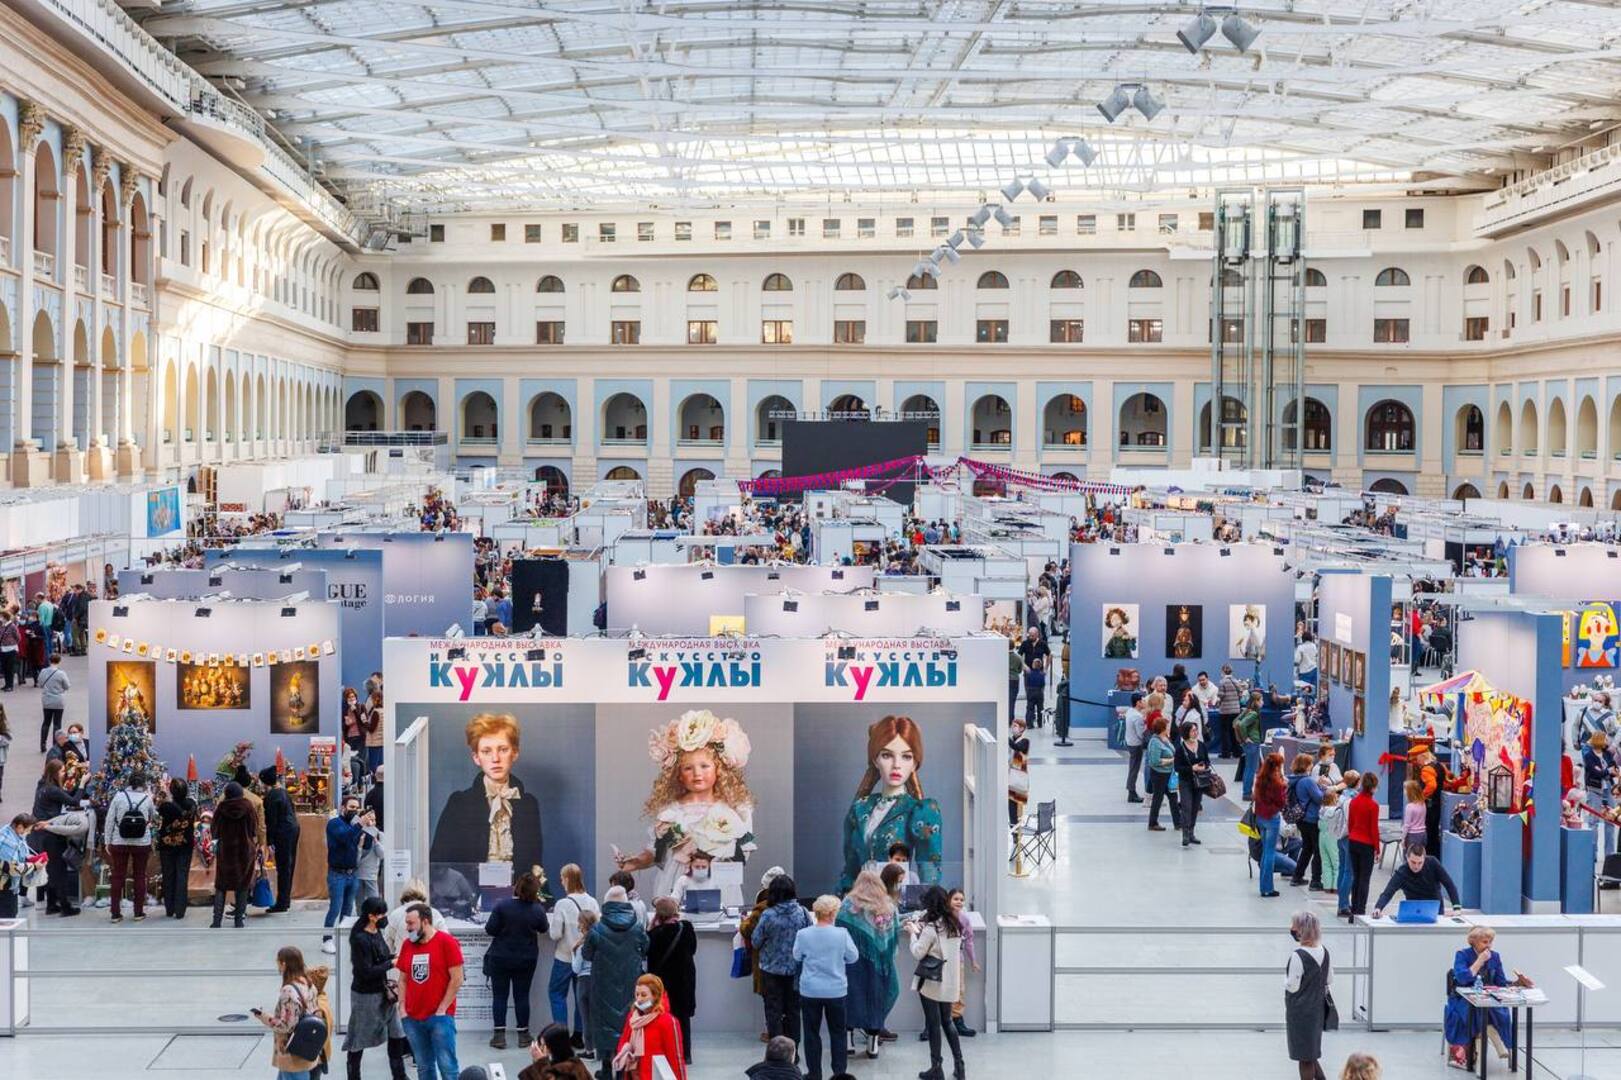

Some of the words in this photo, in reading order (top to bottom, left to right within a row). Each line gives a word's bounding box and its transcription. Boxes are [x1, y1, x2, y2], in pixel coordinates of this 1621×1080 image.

[516, 640, 562, 649] ВЫСАВКА
[714, 640, 760, 649] ВЫСТВКА
[825, 640, 907, 649] МЕУНАРОДНАЯ
[911, 640, 957, 649] ВЫСТАВ
[430, 652, 562, 661] ИКУССО
[628, 652, 760, 661] СКУССТО
[825, 652, 958, 661] ИКУССТВО
